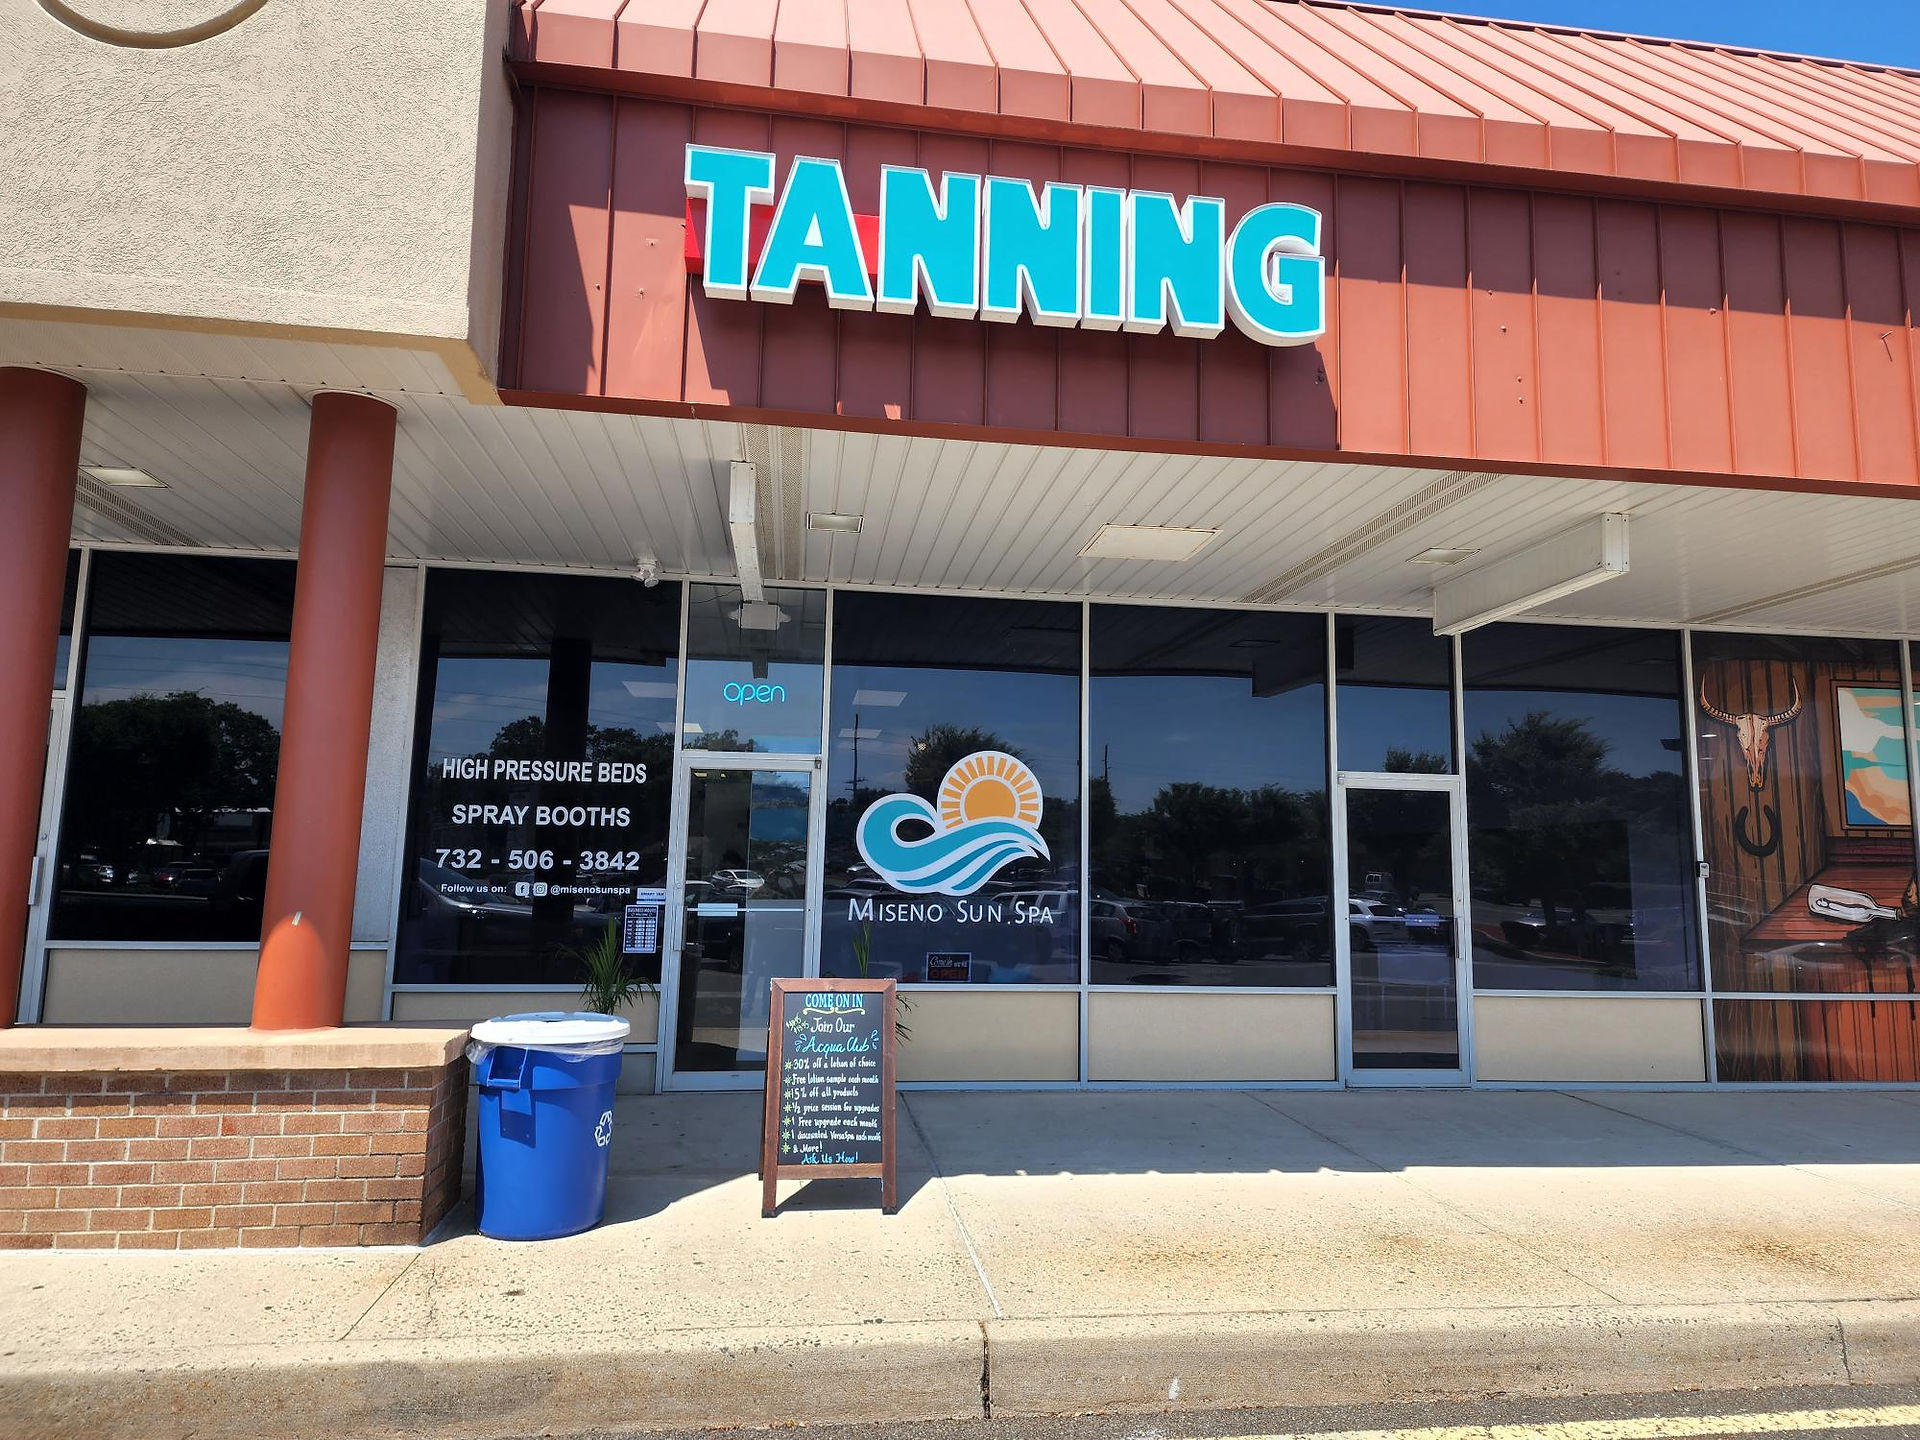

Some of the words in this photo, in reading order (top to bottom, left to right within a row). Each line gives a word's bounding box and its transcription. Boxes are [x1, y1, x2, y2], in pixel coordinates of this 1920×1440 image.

[684, 143, 1326, 347] TANNING
[723, 682, 785, 706] open
[442, 758, 488, 780] HIGH
[493, 759, 593, 783] PRESSURE
[598, 762, 647, 784] BEDS
[452, 804, 530, 826] SPRAY
[535, 806, 631, 827] BOOTHS
[435, 849, 482, 869] 732
[508, 850, 554, 870] 506
[579, 851, 641, 871] 3842
[441, 883, 474, 894] Follow
[477, 885, 488, 894] us
[491, 884, 507, 894] on:
[550, 884, 631, 897] @misenosunspa
[847, 898, 943, 923] MISENO
[957, 899, 1002, 923] SUN
[1014, 901, 1054, 925] SPA
[805, 993, 833, 1007] COME
[835, 993, 850, 1008] ON
[852, 993, 864, 1008] IN
[810, 1016, 833, 1033] Join
[835, 1016, 855, 1033] Our
[802, 1035, 846, 1059] Acqua
[846, 1036, 870, 1052] Club
[793, 1057, 810, 1069] 30%
[812, 1057, 822, 1068] off
[830, 1056, 849, 1068] lotion
[849, 1057, 857, 1068] of
[858, 1056, 876, 1067] choice
[791, 1073, 806, 1085] Free
[807, 1072, 825, 1084] lotion
[826, 1073, 847, 1084] sample
[848, 1074, 860, 1083] each
[861, 1075, 879, 1084] month
[791, 1086, 807, 1100] 15%
[809, 1086, 819, 1097] off
[821, 1086, 831, 1097] all
[832, 1086, 859, 1099] products
[803, 1103, 819, 1115] price
[821, 1102, 842, 1112] session
[843, 1102, 852, 1112] for
[854, 1103, 880, 1114] upgrades
[798, 1116, 812, 1127] Free
[814, 1116, 841, 1128] upgrade
[843, 1115, 858, 1127] each
[860, 1118, 878, 1128] month
[797, 1129, 828, 1140] discounted
[856, 1130, 867, 1141] each
[800, 1140, 823, 1153] More!
[801, 1152, 819, 1164] Ask
[821, 1153, 832, 1164] Us
[835, 1151, 858, 1164] How!
